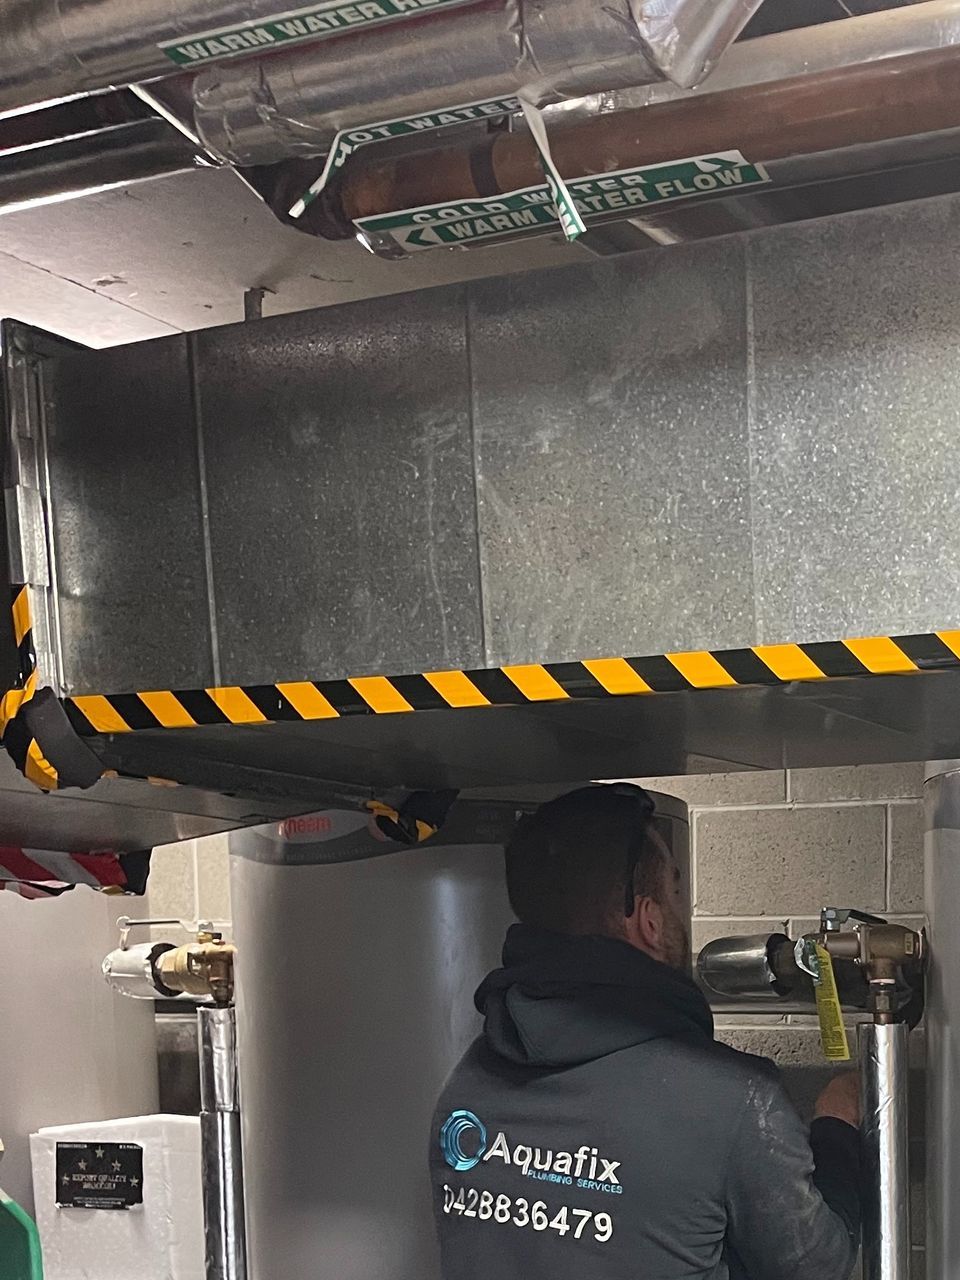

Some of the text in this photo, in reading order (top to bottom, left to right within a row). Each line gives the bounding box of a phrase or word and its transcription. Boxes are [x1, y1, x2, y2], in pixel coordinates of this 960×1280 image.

[176, 27, 276, 60] WARM
[274, 0, 388, 38] WATER
[412, 202, 511, 223] COLD
[447, 208, 539, 239] WARM
[654, 168, 743, 198] FLOW
[482, 1131, 621, 1185] Aquafix
[527, 1169, 623, 1194] PLUMBING SERVICES
[443, 1184, 613, 1243] 0428836479
